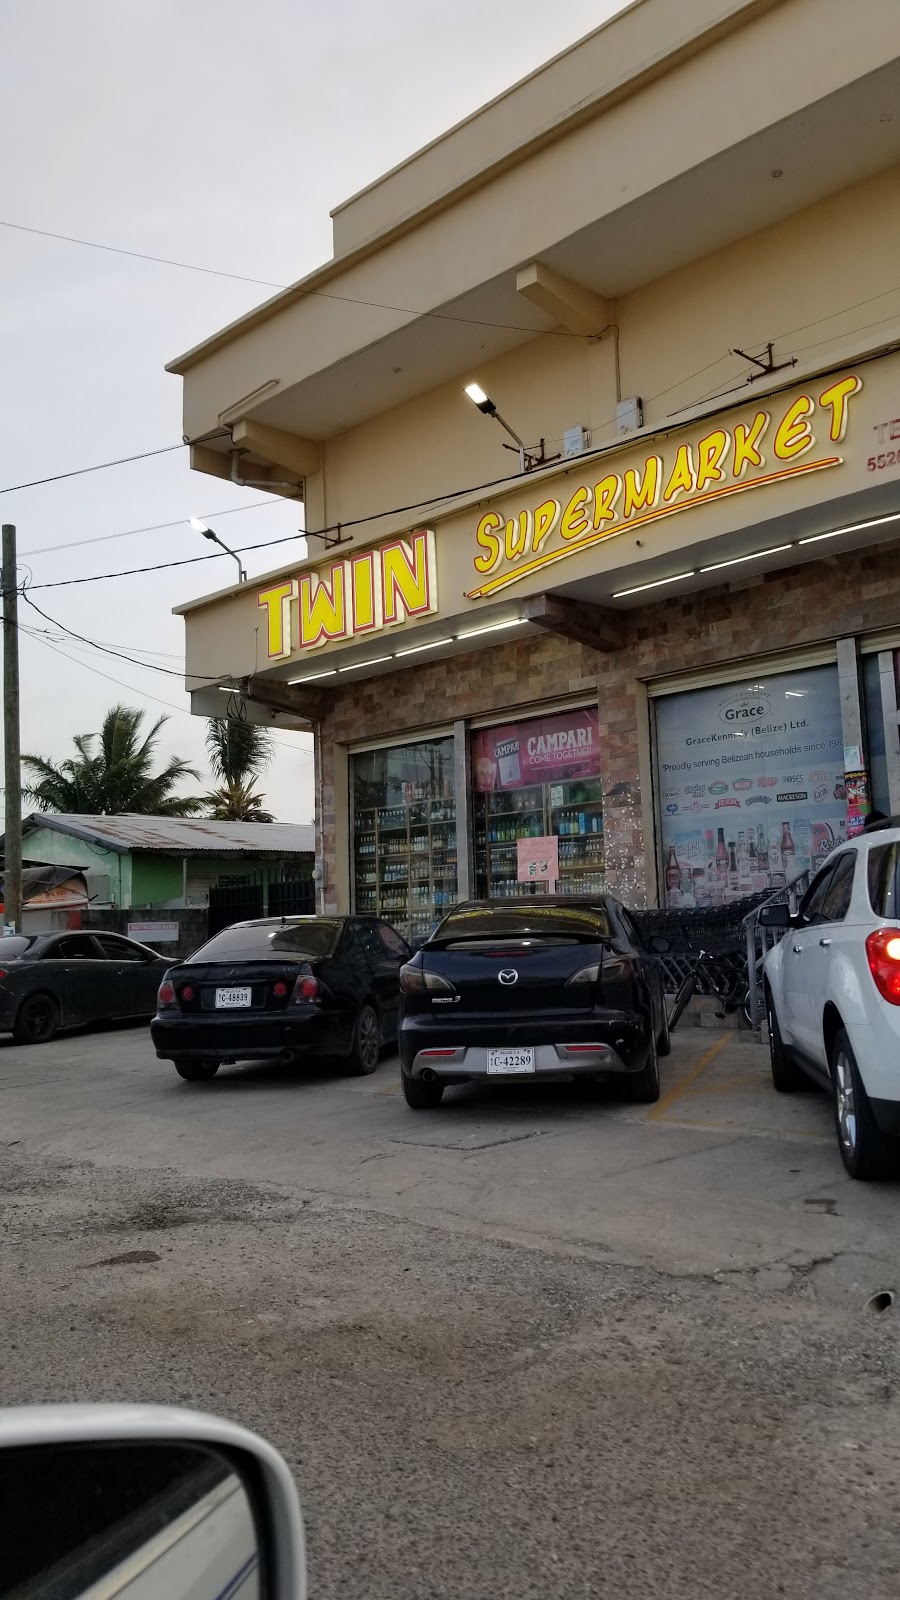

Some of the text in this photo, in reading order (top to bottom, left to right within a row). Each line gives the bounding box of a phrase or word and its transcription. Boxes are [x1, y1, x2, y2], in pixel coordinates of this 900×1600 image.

[258, 374, 863, 661] TWIN SUPERMARKET
[725, 705, 764, 720] Grace
[751, 722, 787, 738] (Belize)
[790, 719, 809, 729] Ltd.
[527, 726, 593, 756] CAMPARI
[529, 753, 551, 765] COME
[552, 746, 592, 760] TOGETHER
[693, 757, 720, 769] serving
[721, 752, 754, 764] Belizean
[755, 744, 802, 759] households
[804, 741, 826, 752] since
[718, 798, 737, 806] DEVON
[777, 792, 807, 801] MACKESON
[494, 1055, 531, 1066] C-42289
